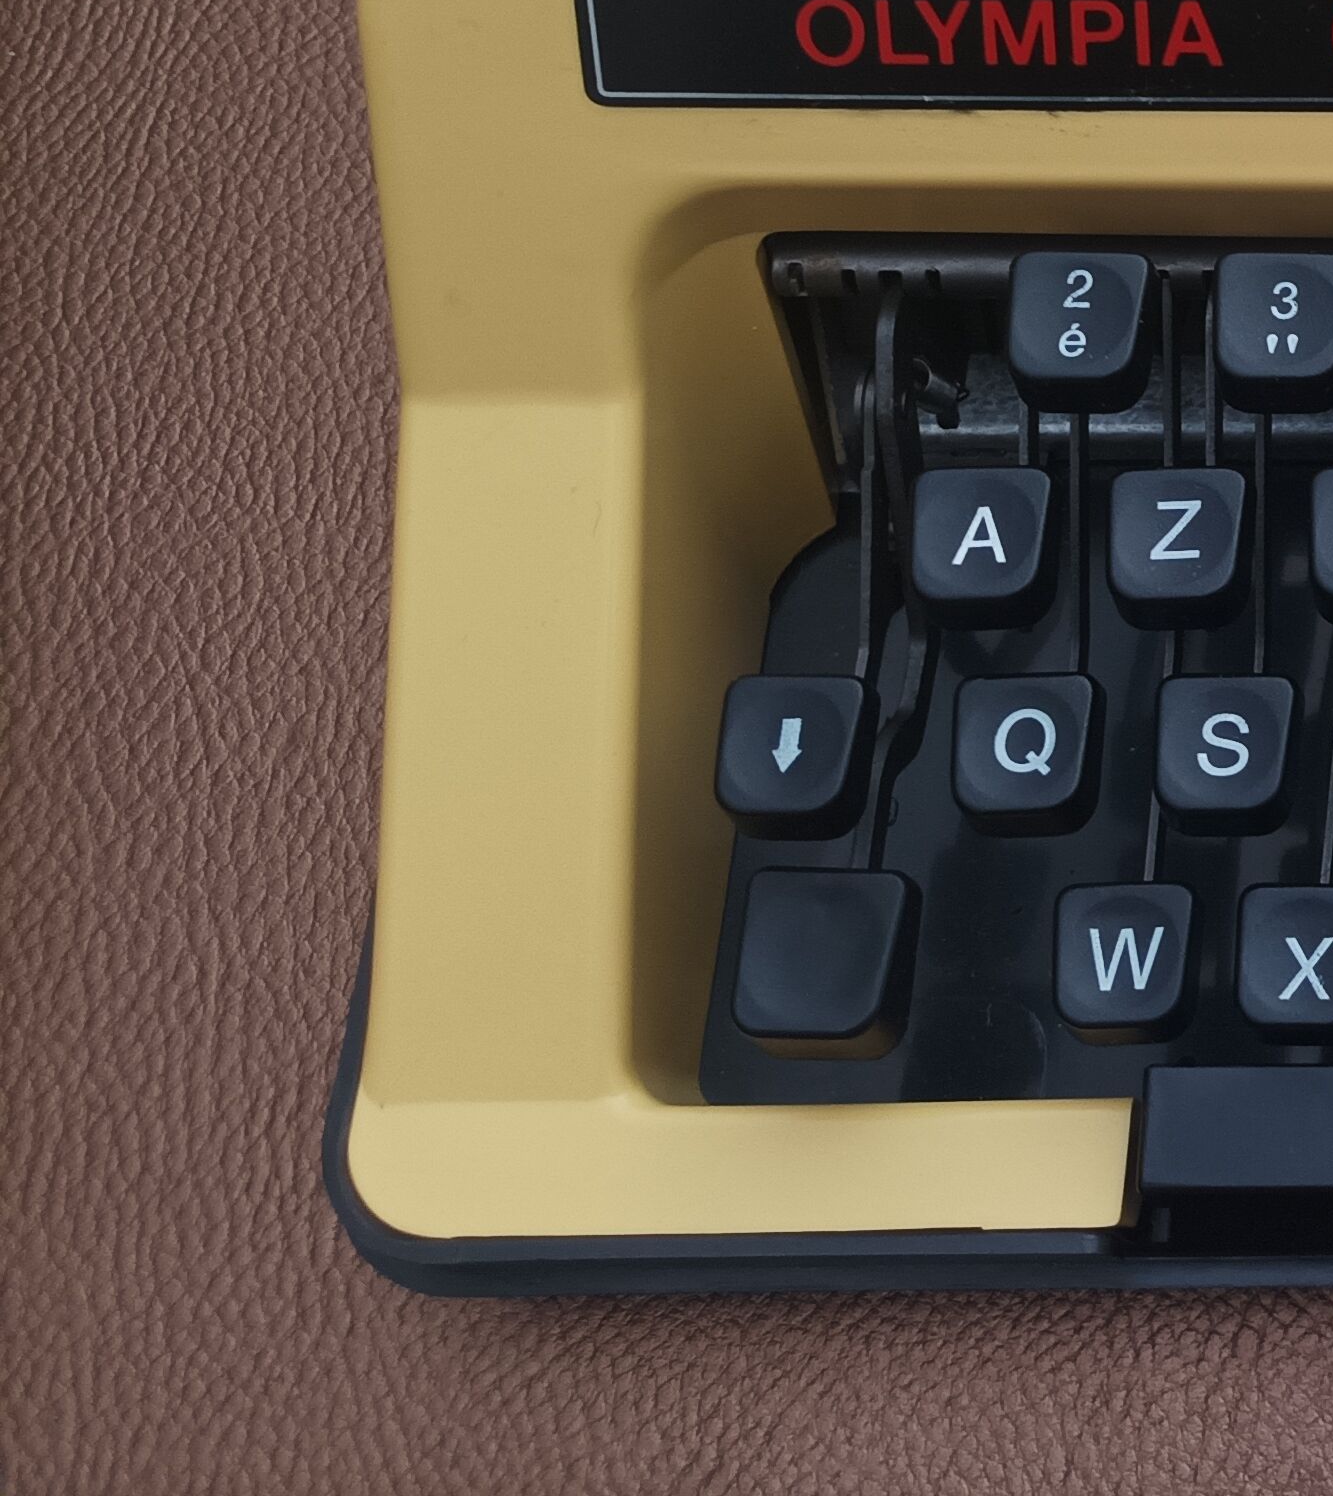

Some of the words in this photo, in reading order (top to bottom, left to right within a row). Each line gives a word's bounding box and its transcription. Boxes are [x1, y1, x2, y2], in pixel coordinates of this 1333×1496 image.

[1062, 269, 1094, 309] 2
[1270, 281, 1298, 320] 3
[1057, 321, 1087, 358] é
[951, 506, 1007, 566] A
[1149, 499, 1202, 561] Z
[994, 708, 1056, 776] Q
[1196, 713, 1250, 777] S
[1089, 926, 1165, 992] W
